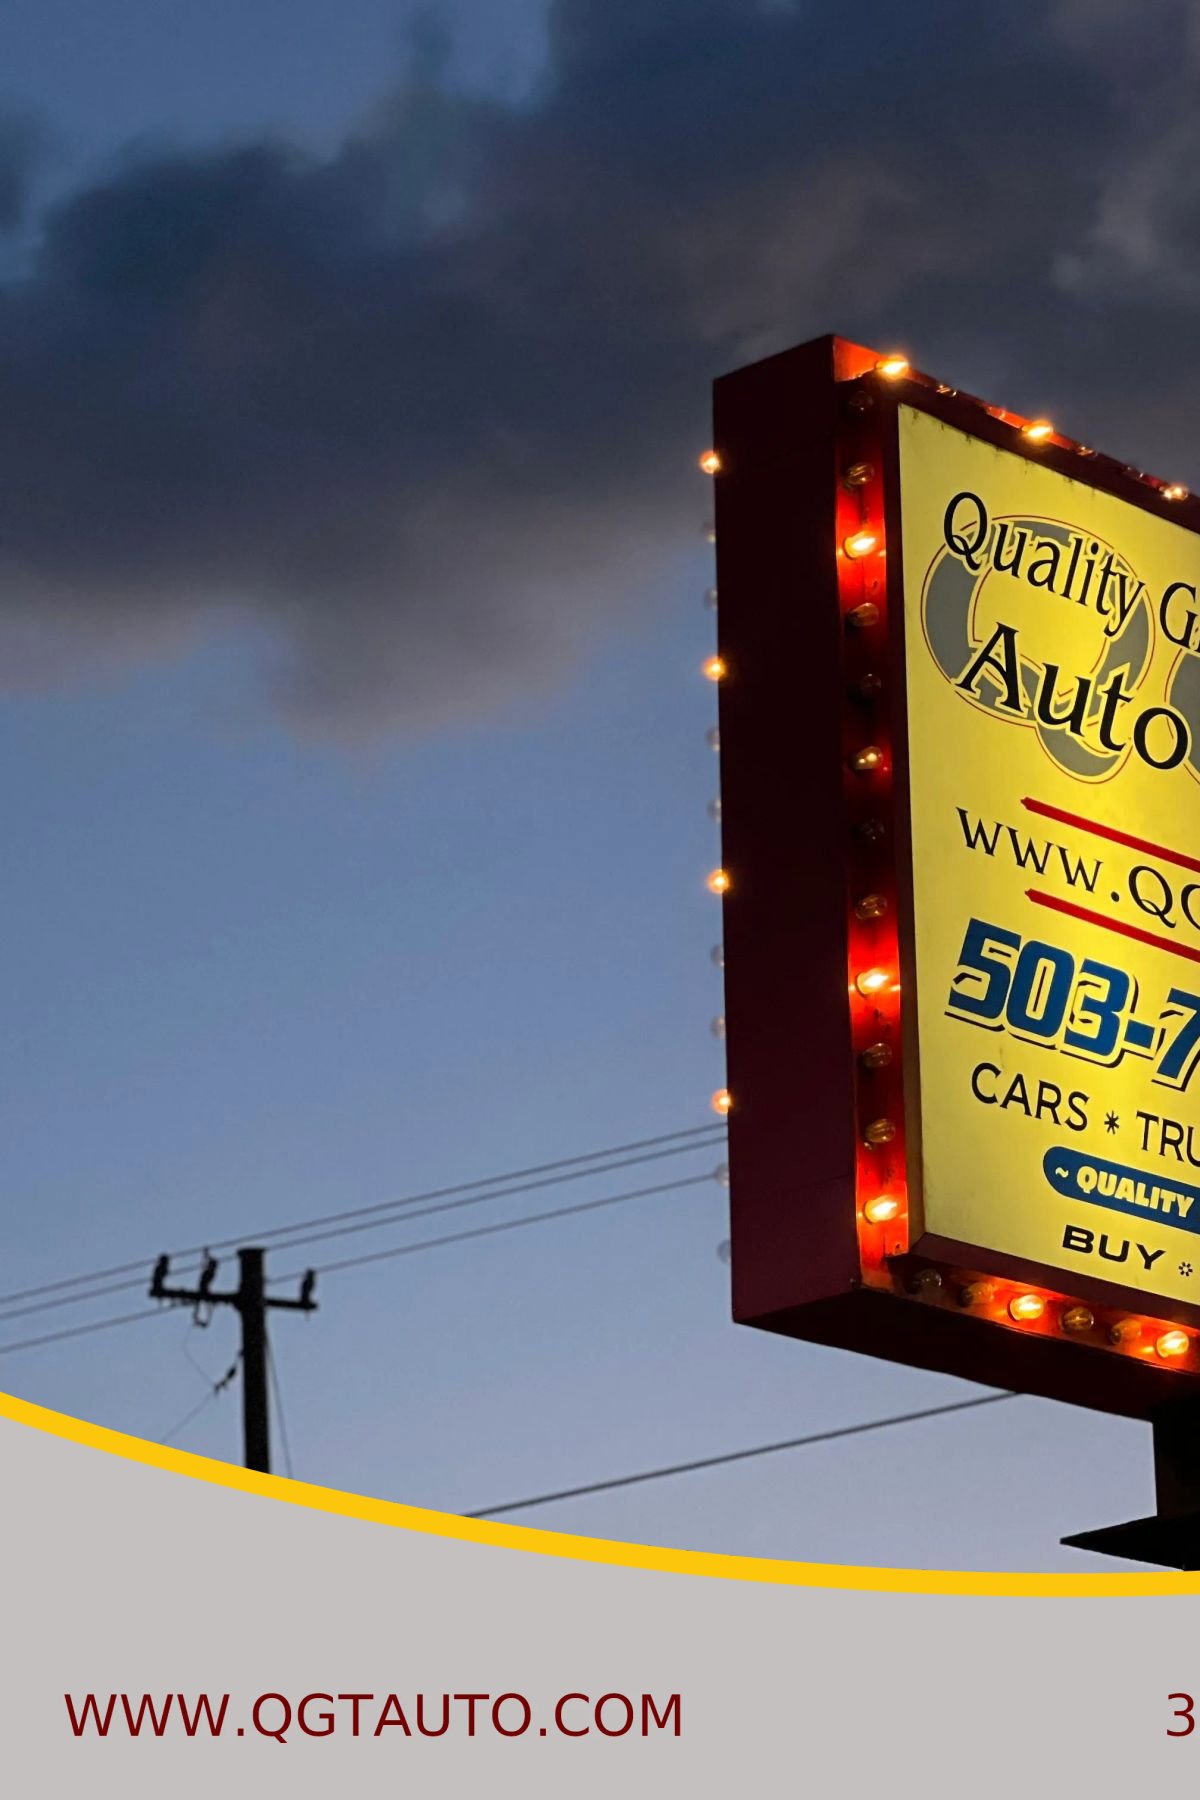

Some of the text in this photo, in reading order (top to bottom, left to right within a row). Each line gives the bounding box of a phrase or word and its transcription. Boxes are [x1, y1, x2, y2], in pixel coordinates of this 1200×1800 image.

[942, 491, 1146, 637] Quality
[955, 622, 1190, 770] Auto
[971, 1063, 1088, 1132] CARS
[1077, 1166, 1194, 1218] QUALITY
[1062, 1225, 1166, 1278] BUY
